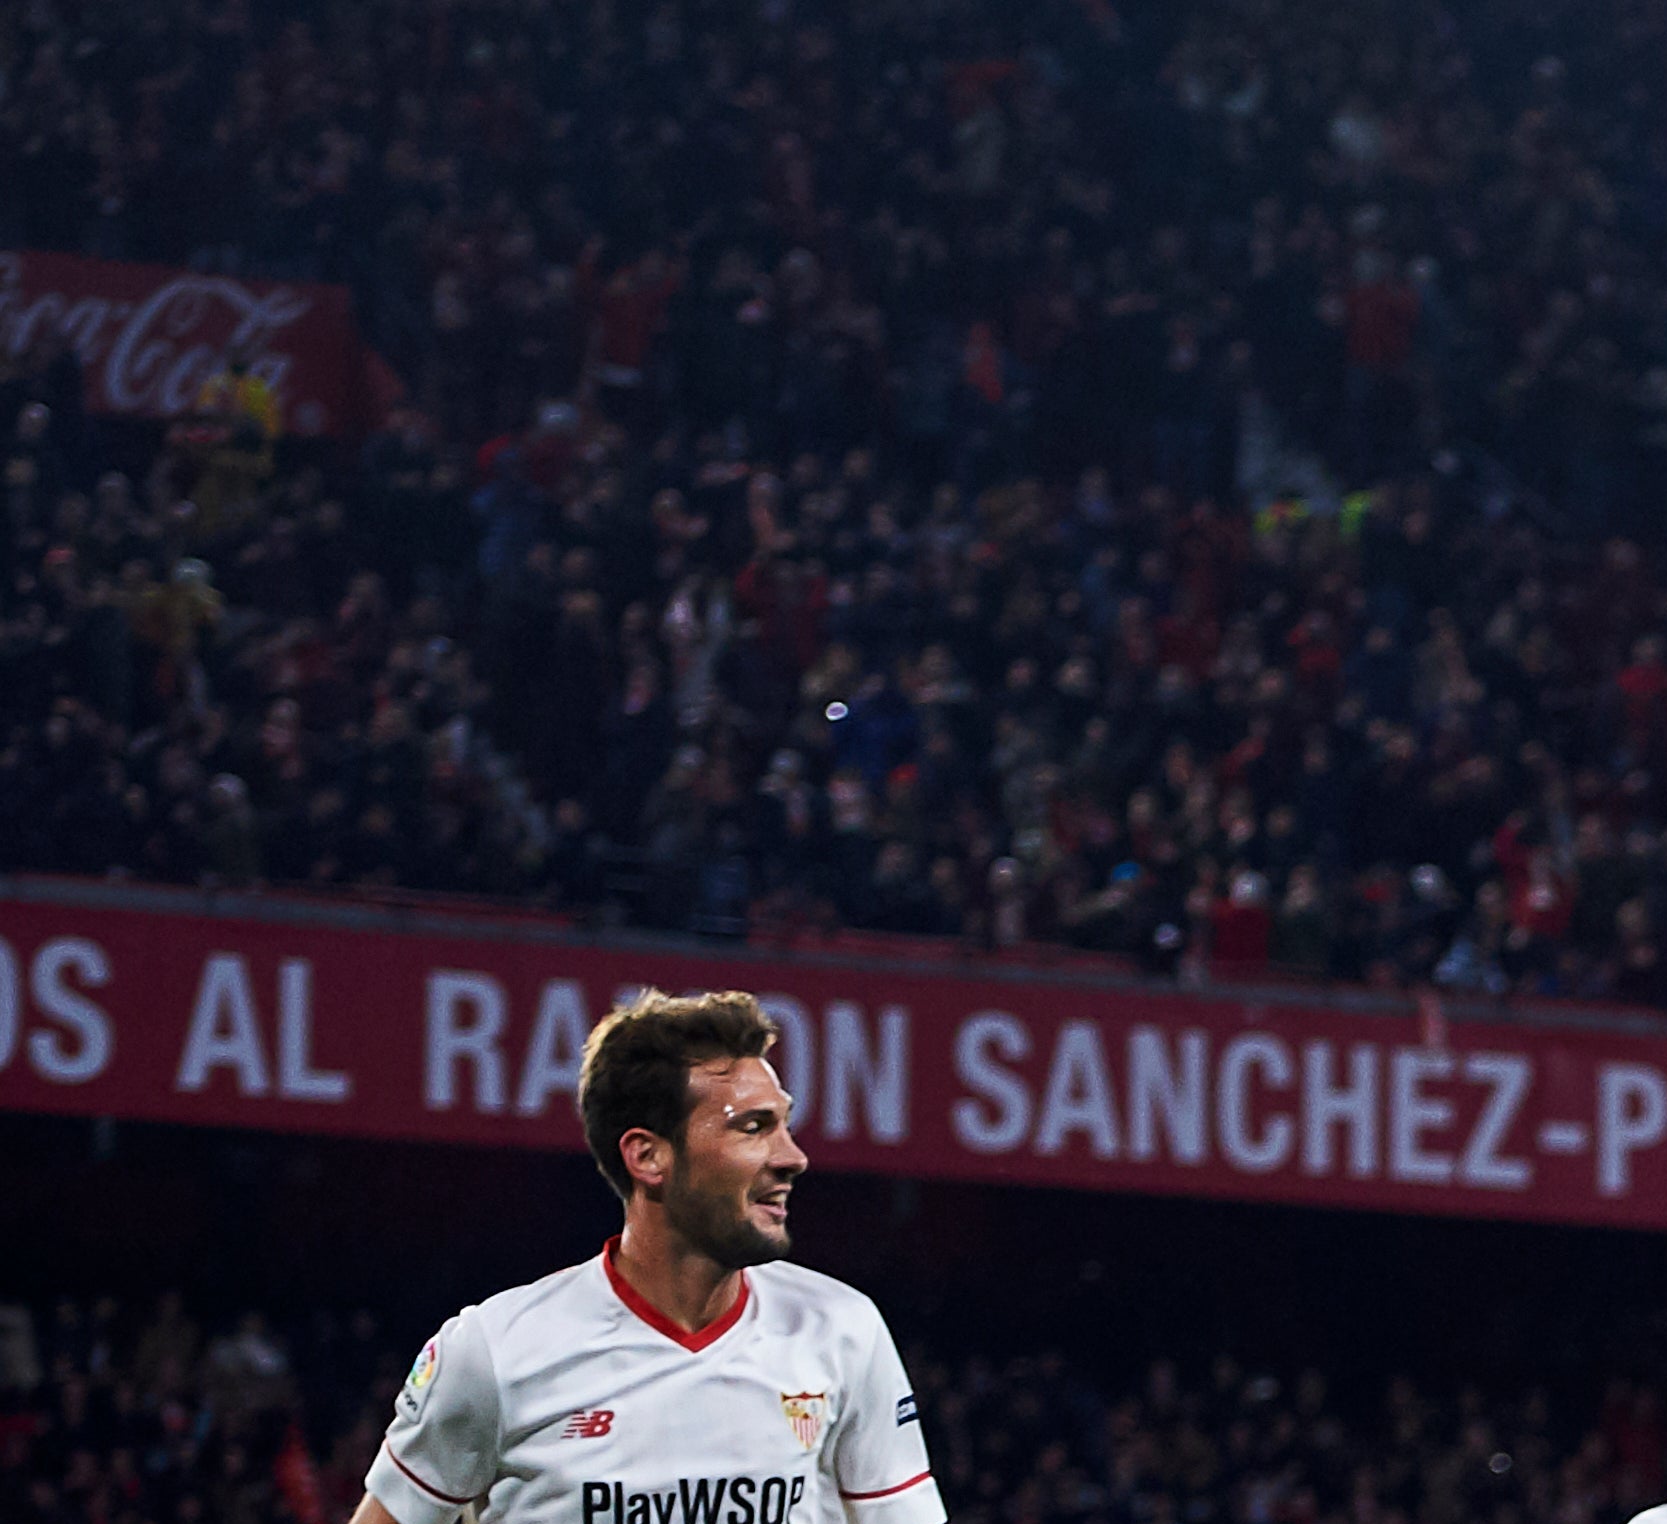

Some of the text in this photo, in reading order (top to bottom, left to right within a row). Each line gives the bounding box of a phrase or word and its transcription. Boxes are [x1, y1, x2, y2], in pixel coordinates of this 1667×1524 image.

[0, 936, 111, 1084] S
[178, 953, 350, 1103] AL
[423, 968, 909, 1146] RAON
